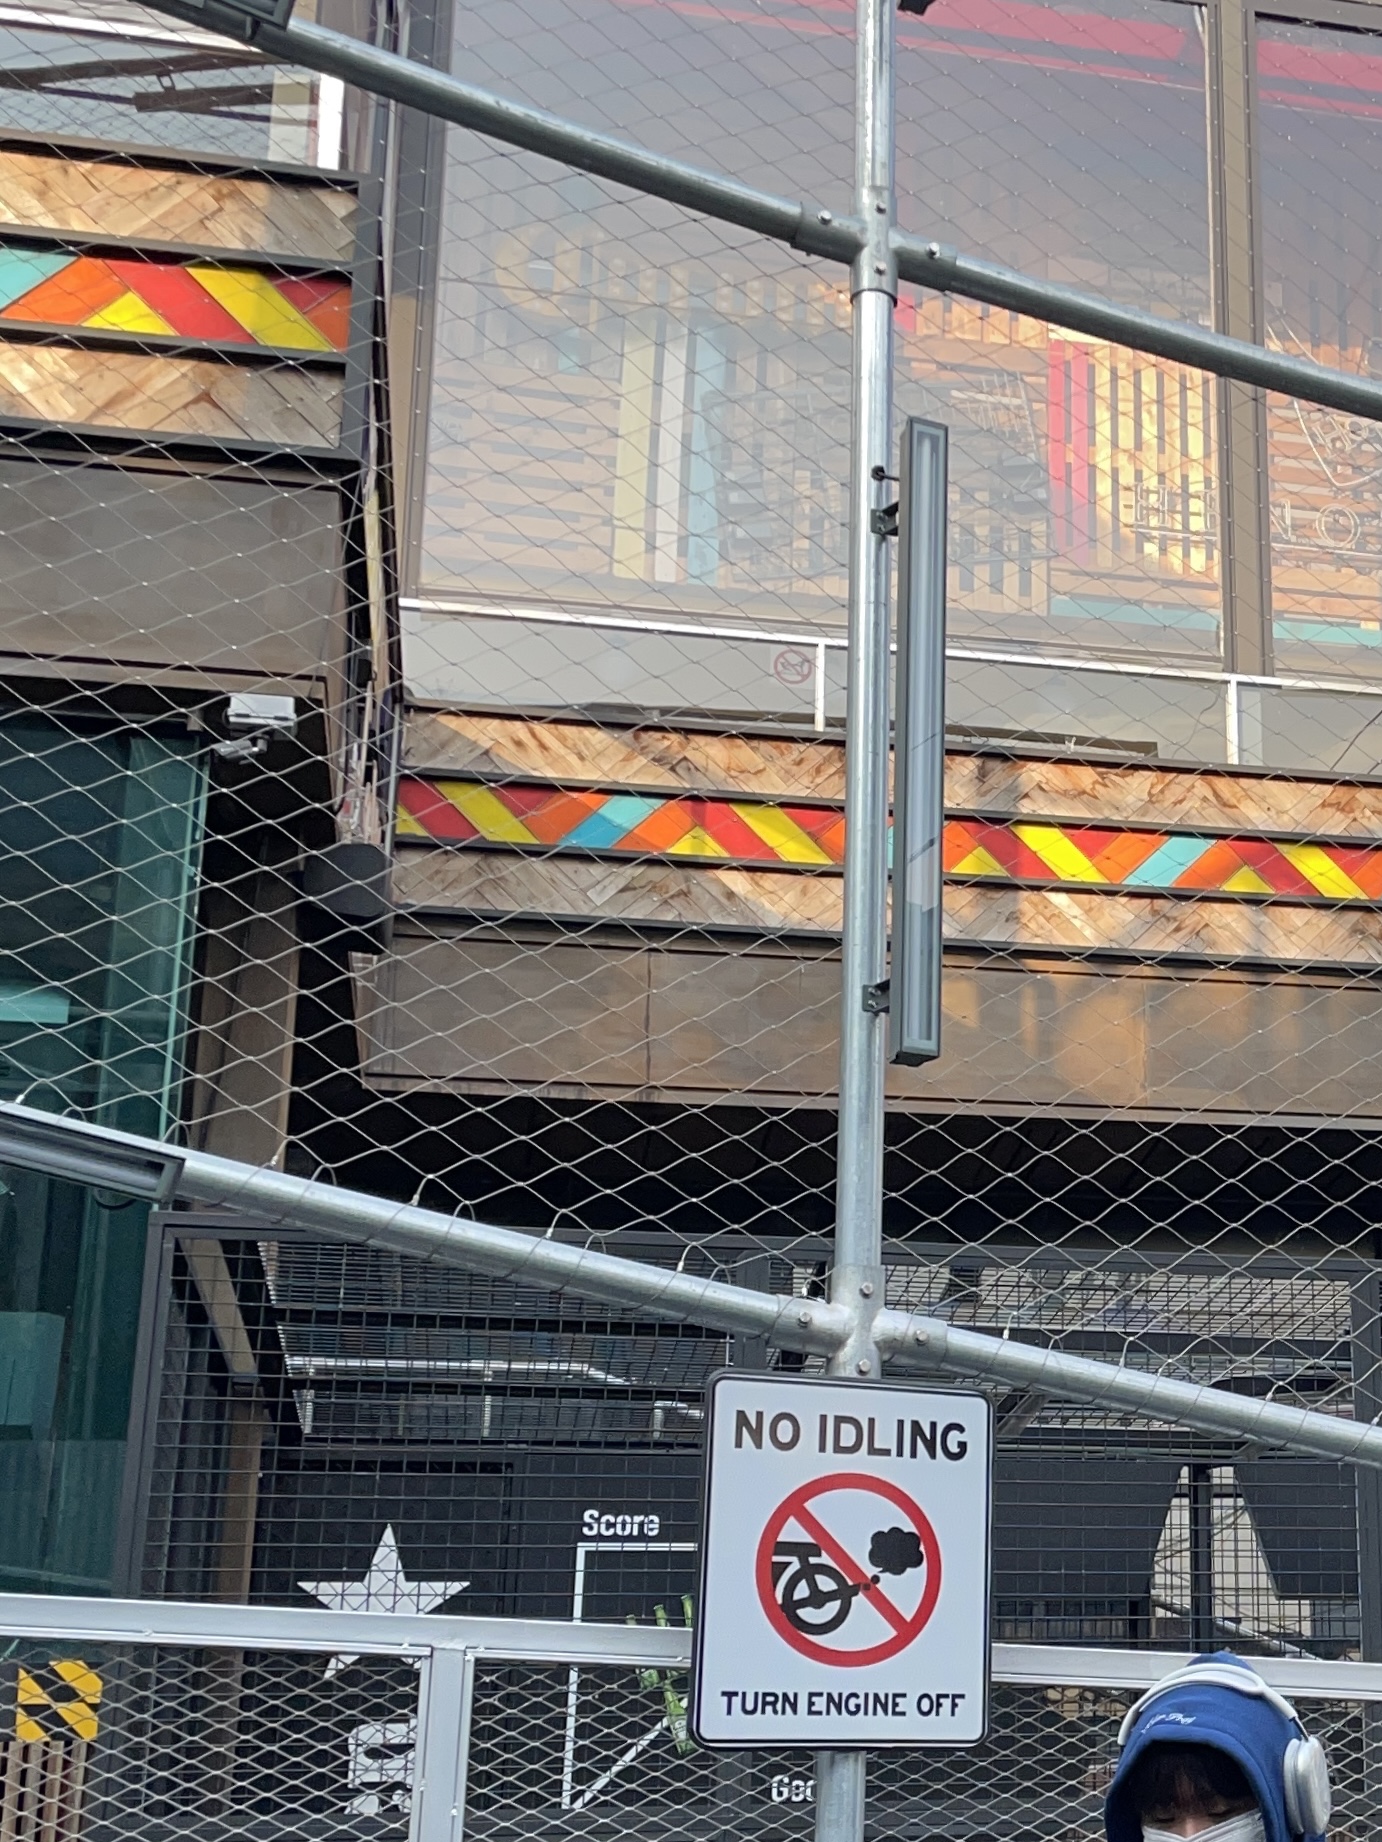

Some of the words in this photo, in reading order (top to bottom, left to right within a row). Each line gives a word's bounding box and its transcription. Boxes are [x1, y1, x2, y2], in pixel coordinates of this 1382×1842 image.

[734, 1409, 801, 1451] NO
[818, 1413, 968, 1461] IDLING
[582, 1509, 660, 1537] Score
[721, 1690, 799, 1716] TURN
[807, 1691, 908, 1717] ENGINE
[916, 1693, 966, 1717] OFF
